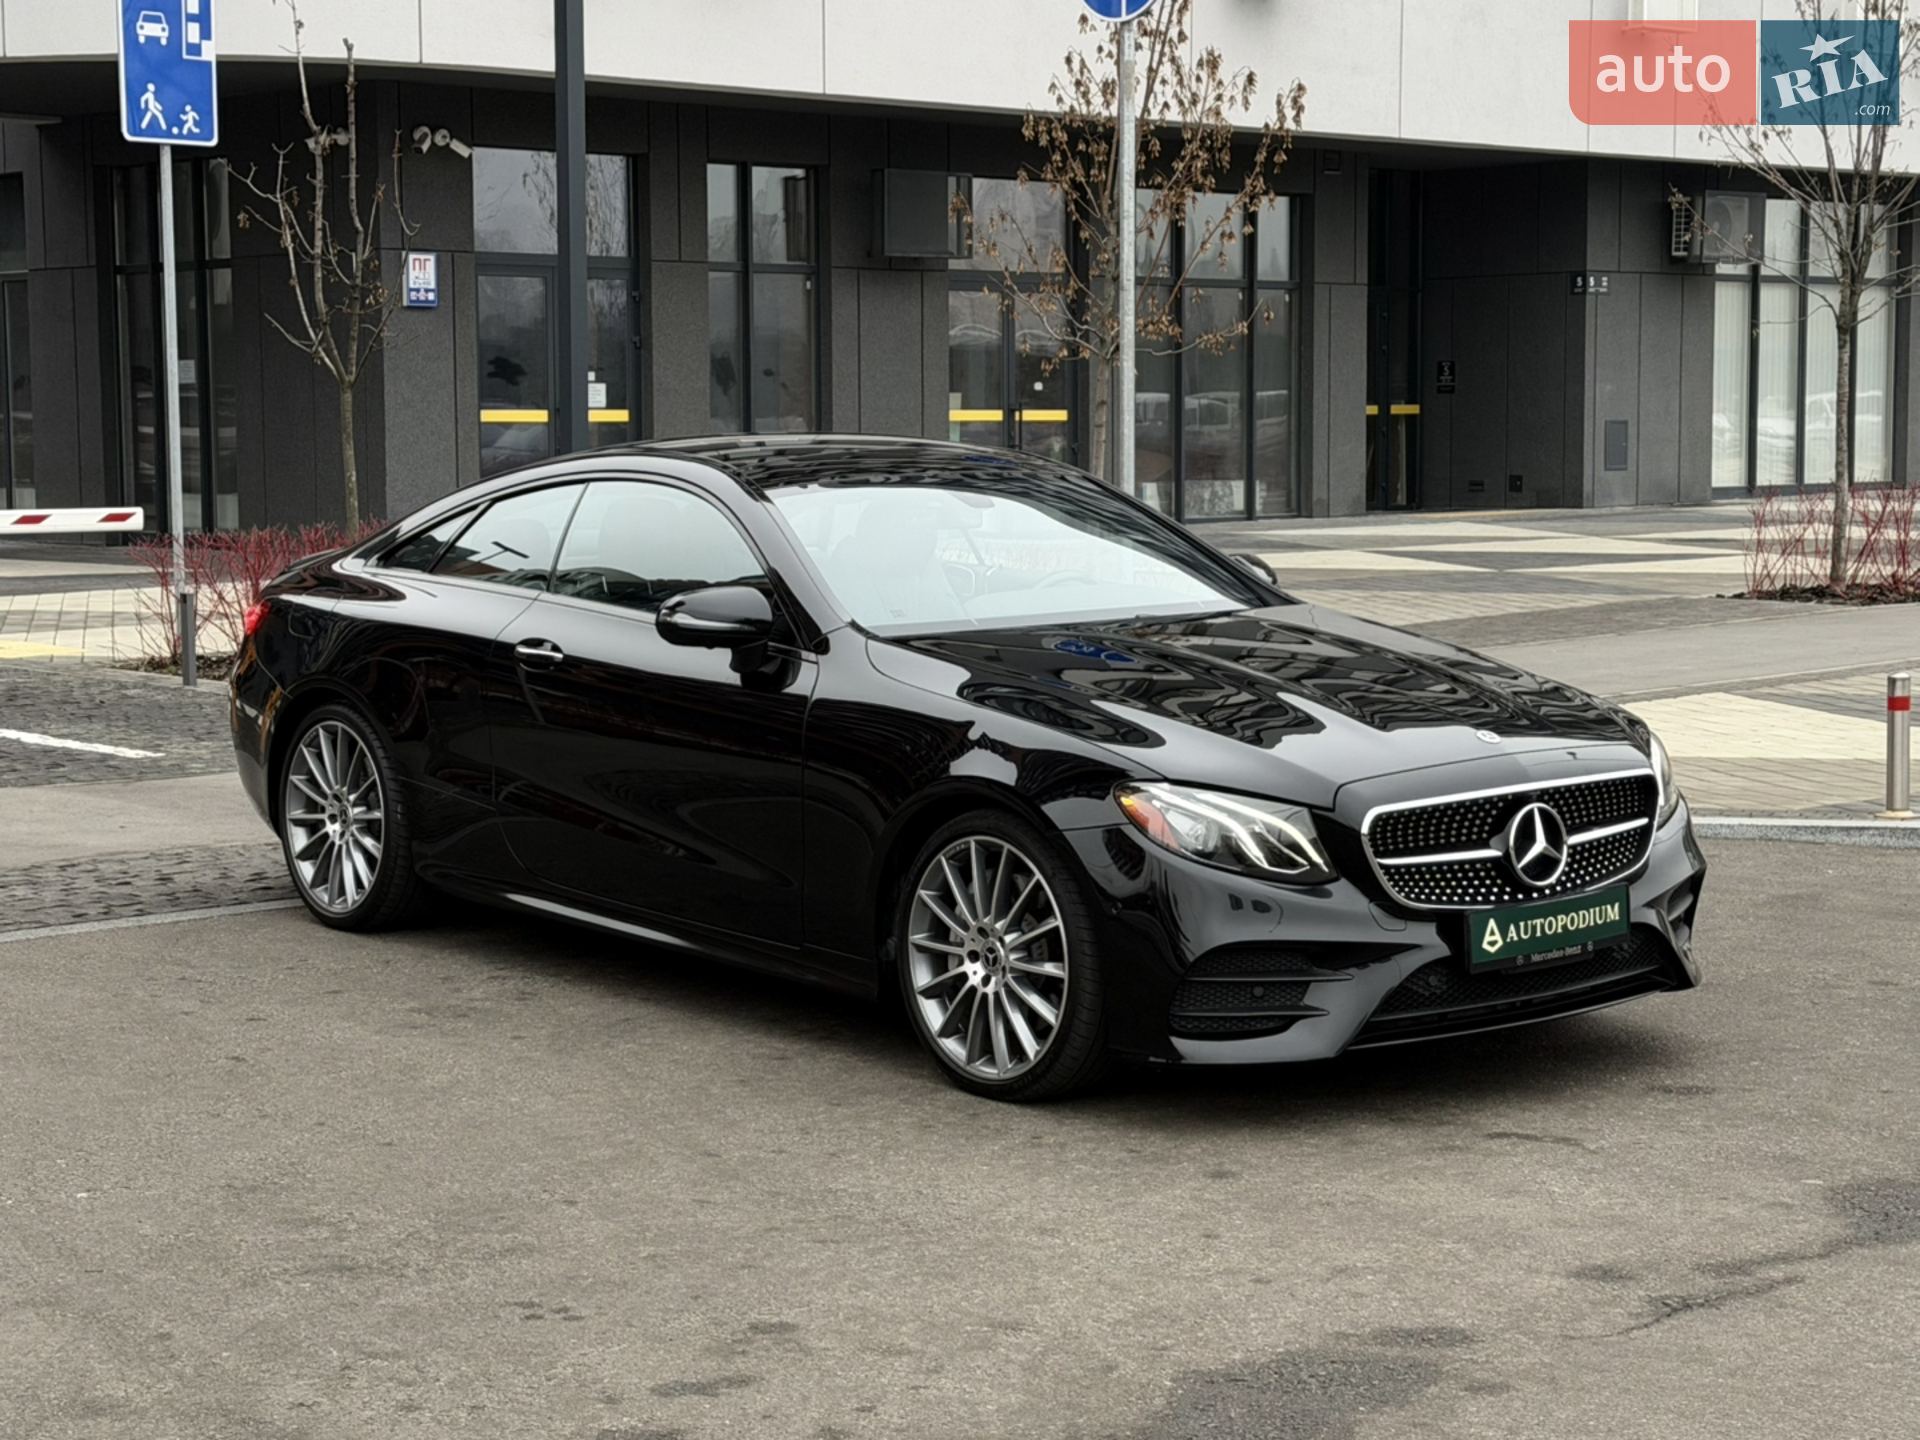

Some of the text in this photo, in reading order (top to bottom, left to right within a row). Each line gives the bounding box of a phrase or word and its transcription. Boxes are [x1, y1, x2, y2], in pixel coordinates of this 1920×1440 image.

[413, 257, 432, 271] ПГ
[1506, 902, 1620, 942] AUTOPODIUM
[1530, 945, 1582, 963] Mercedes-Benz
